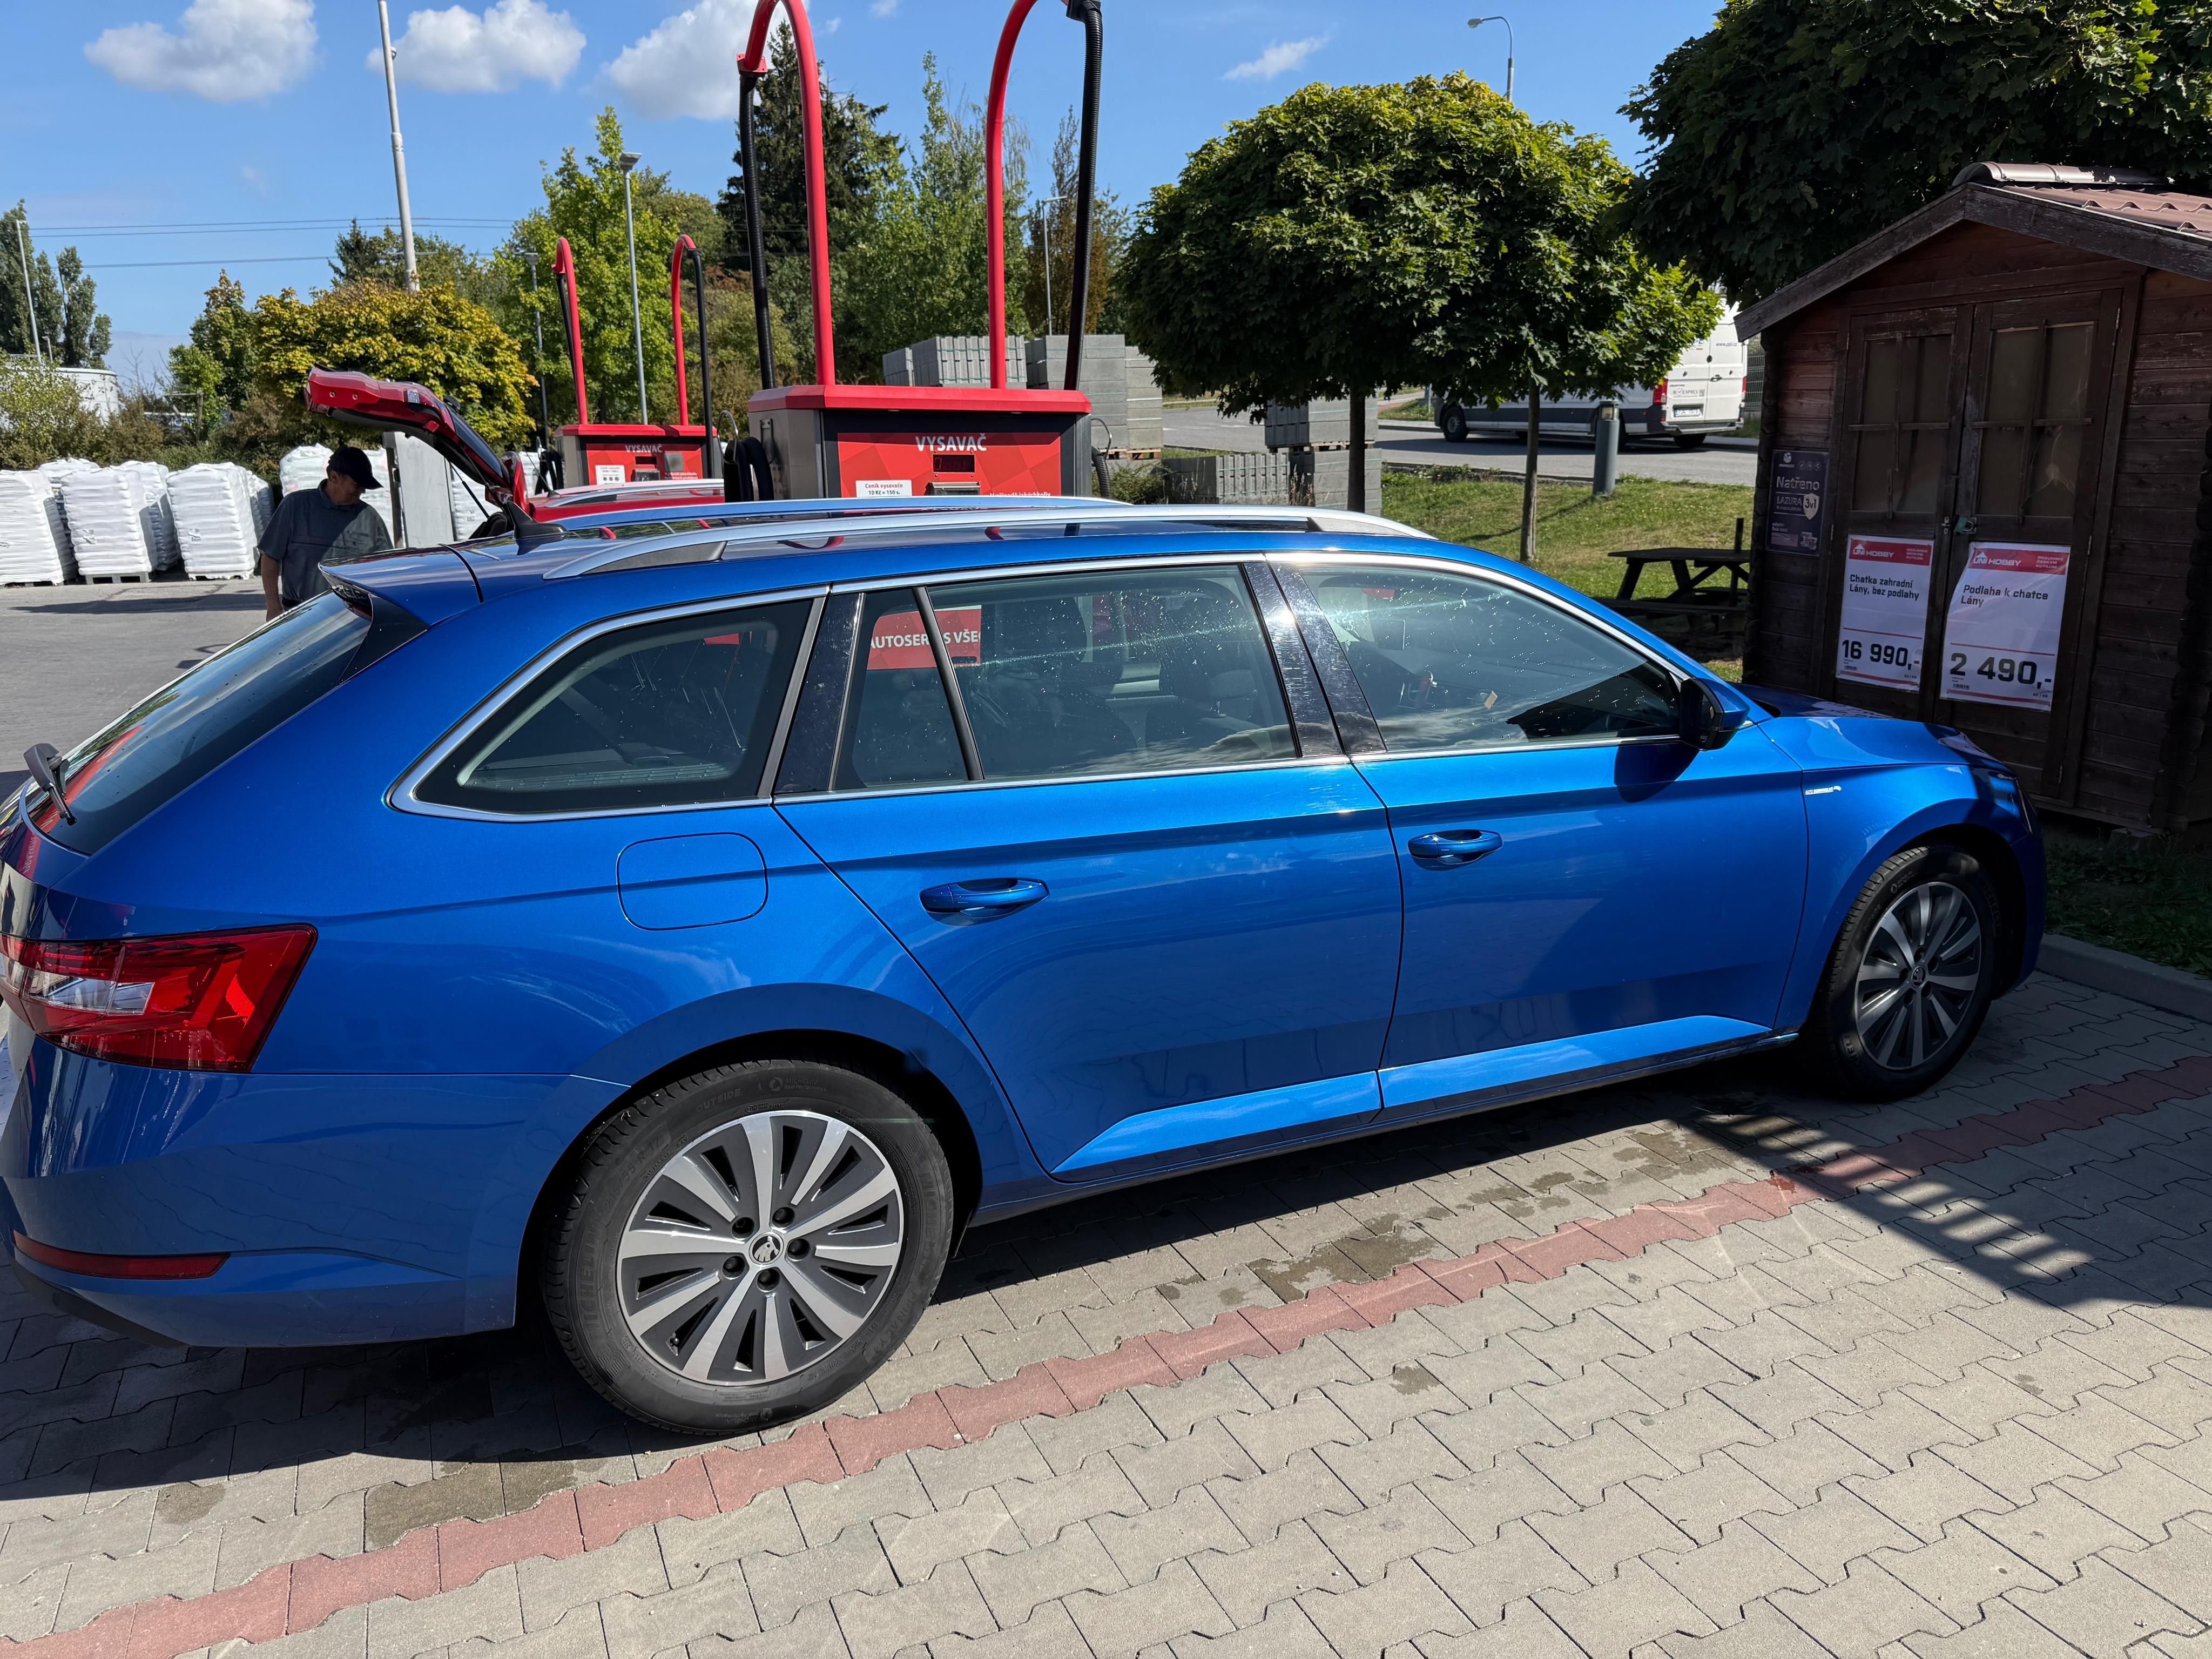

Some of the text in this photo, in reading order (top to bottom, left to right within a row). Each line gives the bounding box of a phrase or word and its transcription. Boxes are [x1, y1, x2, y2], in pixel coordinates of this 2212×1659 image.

[625, 444, 662, 453] VYSAVAČ
[915, 433, 987, 451] VYSAVAČ
[1776, 476, 1820, 491] Natřeno
[1776, 496, 1802, 506] LAZURA
[1804, 498, 1817, 509] 3v1
[1866, 550, 1894, 558] HOBBY
[1850, 574, 1913, 589] Chatka zahradní
[1850, 584, 1919, 602] Lány, bez podlahy
[1963, 584, 2048, 600] Podlaha k chatce
[1960, 595, 1985, 608] Lány
[953, 629, 981, 644] VŠE
[1842, 639, 1920, 671] 16 990,-
[1950, 652, 2052, 689] 2 490,-
[696, 1088, 741, 1112] OUTSIDE
[579, 1218, 603, 1341] MICHELIN
